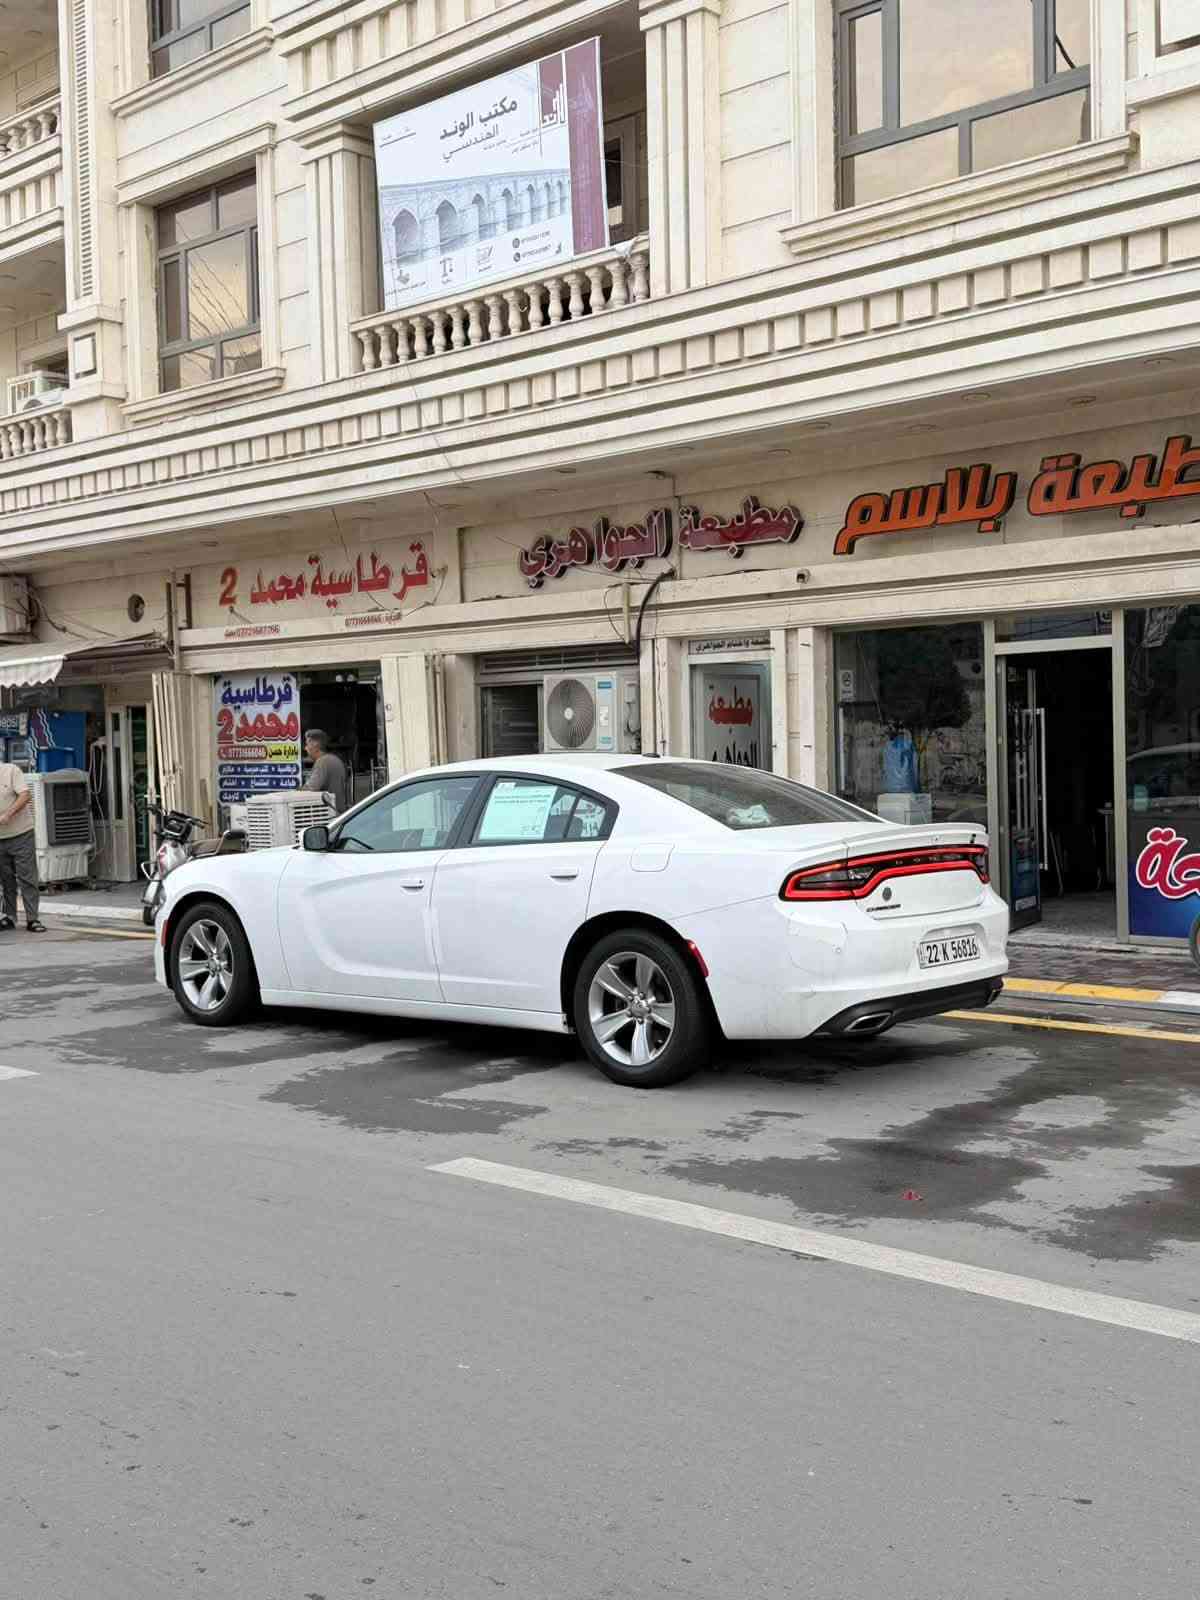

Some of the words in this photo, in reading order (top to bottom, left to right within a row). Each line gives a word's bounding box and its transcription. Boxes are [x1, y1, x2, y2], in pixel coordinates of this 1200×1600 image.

[440, 111, 474, 138] الوند
[479, 96, 518, 127] مكتب
[1027, 434, 1200, 519] طبعة
[678, 495, 804, 559] مطبعة
[833, 463, 1018, 556] بلاسم
[519, 507, 673, 588] الجواهري
[219, 566, 239, 606] 2
[250, 568, 306, 606] محمد
[307, 541, 430, 609] قرطاسية
[221, 676, 293, 710] قرطاسية
[216, 708, 234, 744] 2
[235, 711, 299, 742] محمد
[926, 944, 941, 964] 22
[941, 942, 950, 961] K
[951, 938, 978, 959] 56816
